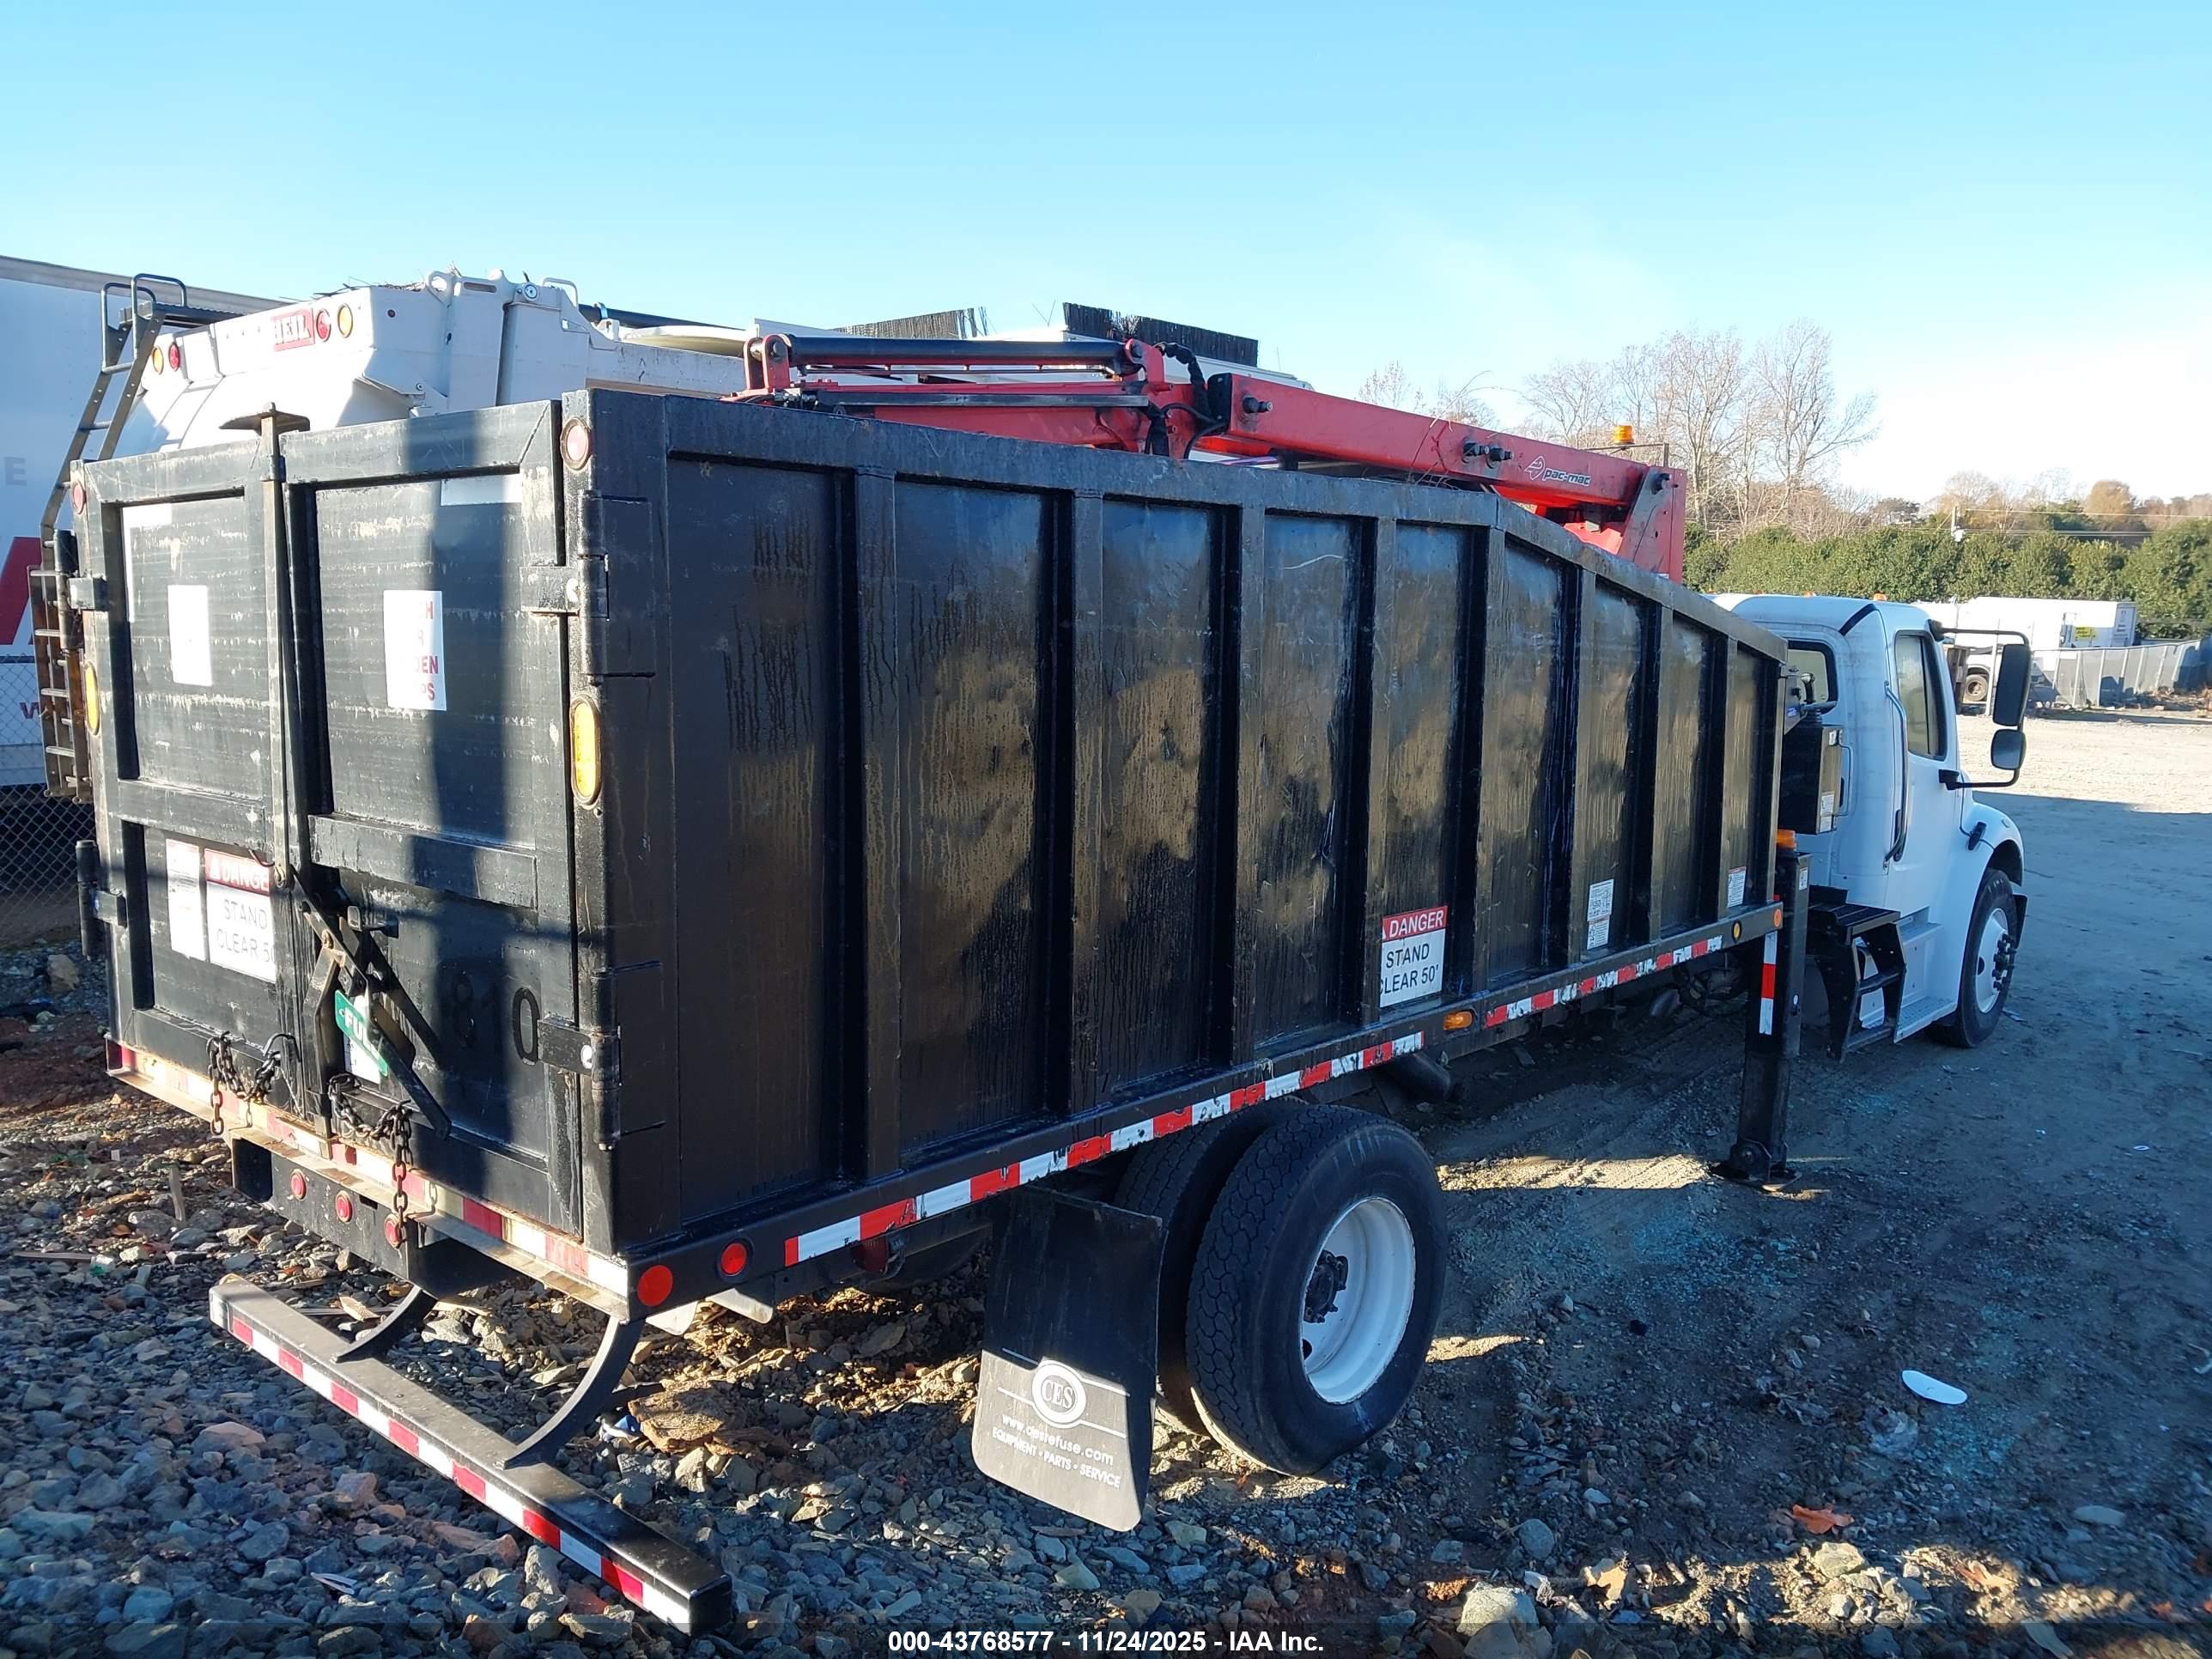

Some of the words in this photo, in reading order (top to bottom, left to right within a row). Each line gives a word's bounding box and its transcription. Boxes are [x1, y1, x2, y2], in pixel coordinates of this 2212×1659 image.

[1544, 469, 1591, 486] pac-mac
[224, 863, 270, 892] DANGE
[223, 899, 268, 929] STAND
[1389, 910, 1443, 938] DANGER
[216, 928, 258, 957] CLEAR
[1386, 944, 1430, 969] STAND
[1042, 1379, 1073, 1409] CES
[992, 1426, 1037, 1457] EQUIPMENT
[1043, 1450, 1072, 1470] PARTS
[1079, 1463, 1121, 1488] SERVICE
